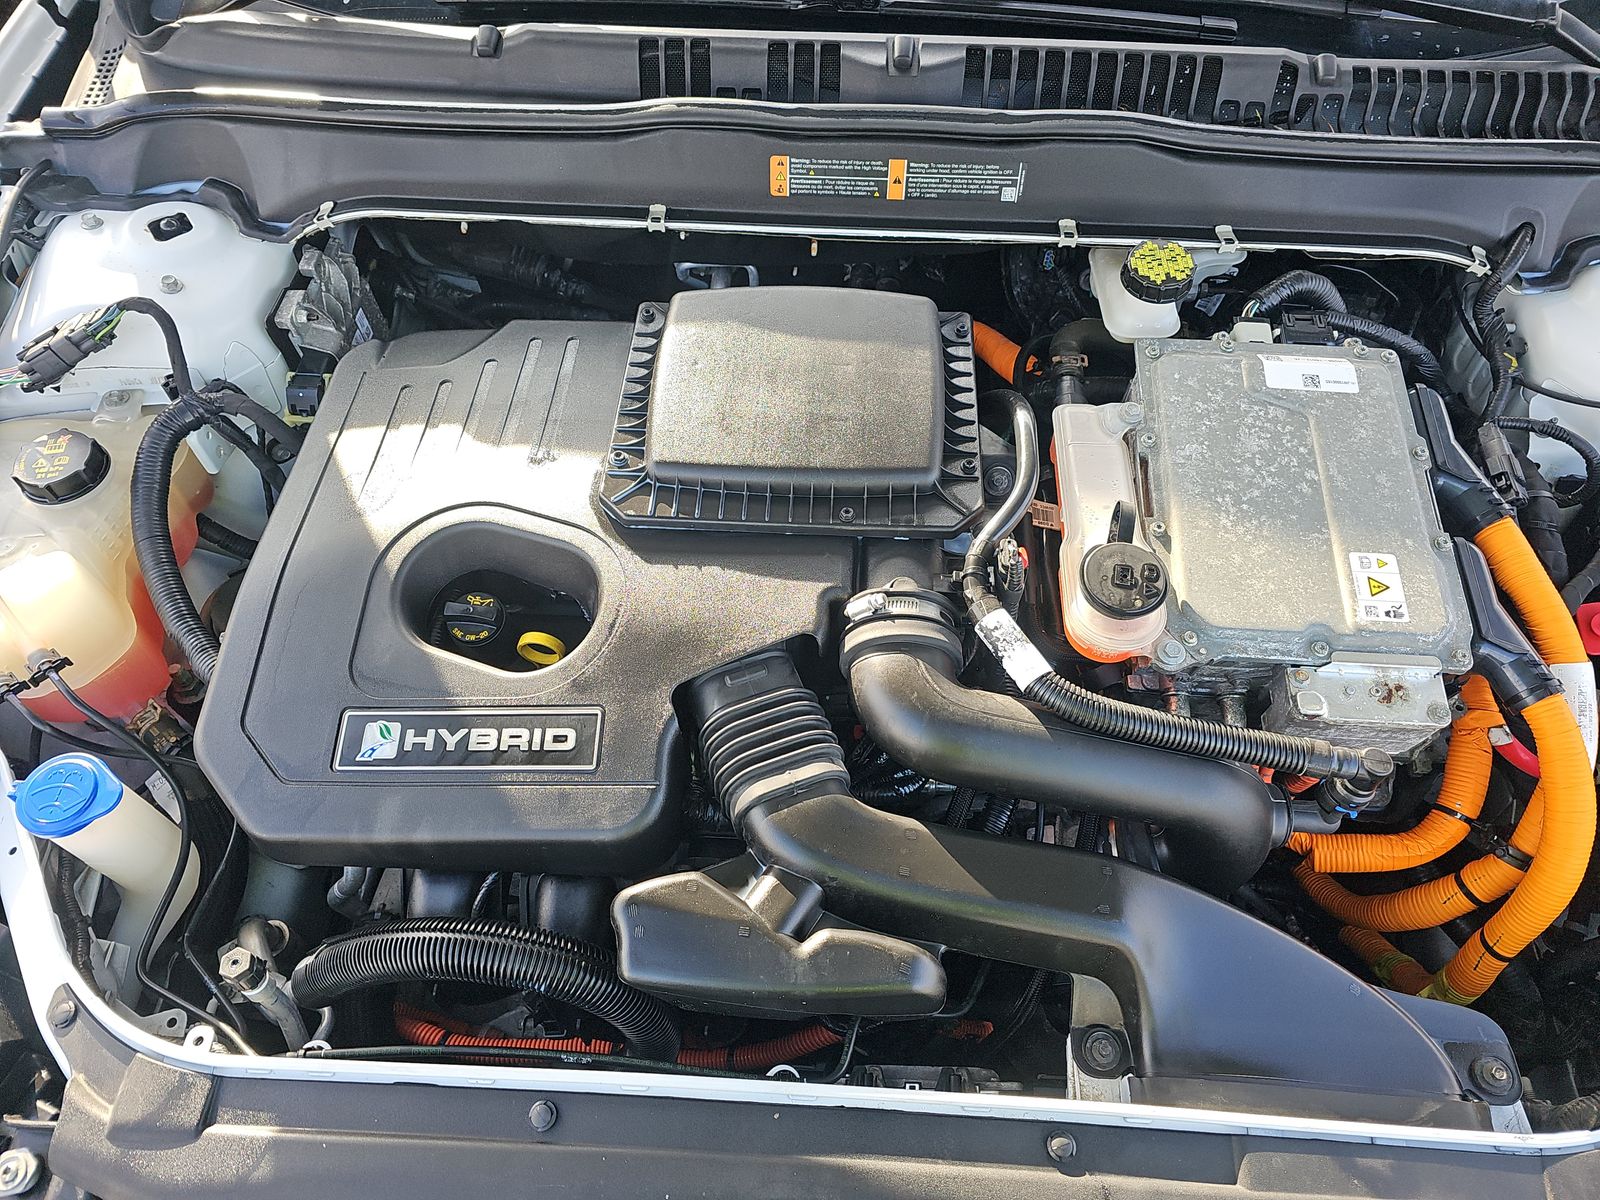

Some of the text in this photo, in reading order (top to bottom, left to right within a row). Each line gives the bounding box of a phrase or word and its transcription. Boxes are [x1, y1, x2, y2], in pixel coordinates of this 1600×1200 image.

[452, 627, 489, 641] SAE 0W-20
[403, 727, 577, 752] HYBRID
